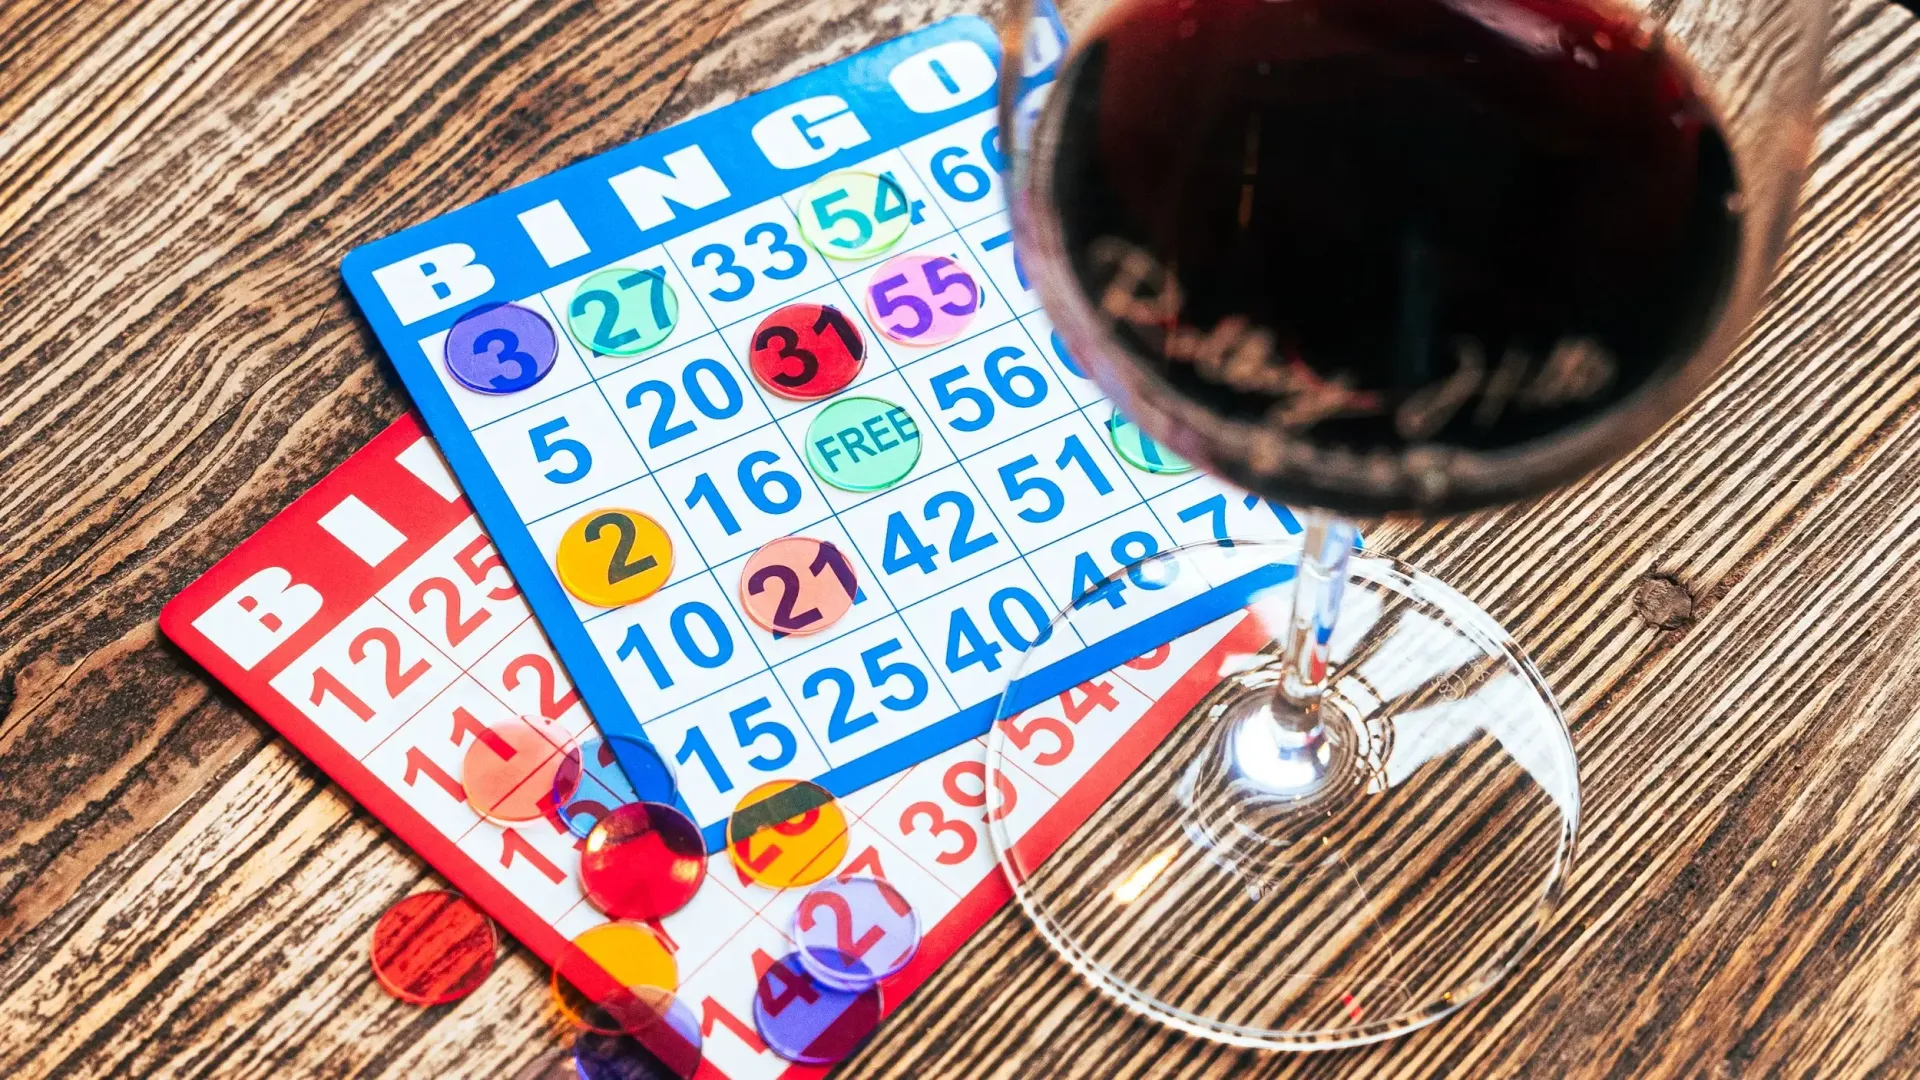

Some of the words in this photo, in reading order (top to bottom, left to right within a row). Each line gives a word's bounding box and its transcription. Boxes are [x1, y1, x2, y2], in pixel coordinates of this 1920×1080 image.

[372, 41, 997, 326] BINGO
[811, 171, 926, 250] 54
[691, 222, 808, 302] 33
[868, 254, 985, 340] 55
[571, 265, 673, 358] 27
[755, 303, 868, 388] 31
[473, 328, 539, 393] 3
[625, 358, 744, 449] 20
[929, 346, 1048, 432] 56
[528, 416, 593, 484] 5
[814, 406, 921, 473] FREE
[997, 434, 1115, 524] 51
[684, 450, 802, 537] 16
[882, 491, 999, 576] 42
[409, 533, 523, 648] 25
[584, 512, 659, 586] 2
[747, 541, 868, 641] 21
[1071, 531, 1181, 610] 48
[616, 601, 734, 690] 10
[945, 586, 1054, 674] 40
[309, 627, 432, 722] 12
[802, 637, 930, 744] 25
[403, 706, 518, 803] 11
[675, 696, 798, 794] 15
[997, 678, 1121, 766] 54
[899, 760, 1018, 866] 39
[797, 845, 912, 968] 27
[701, 947, 821, 1055] 14
